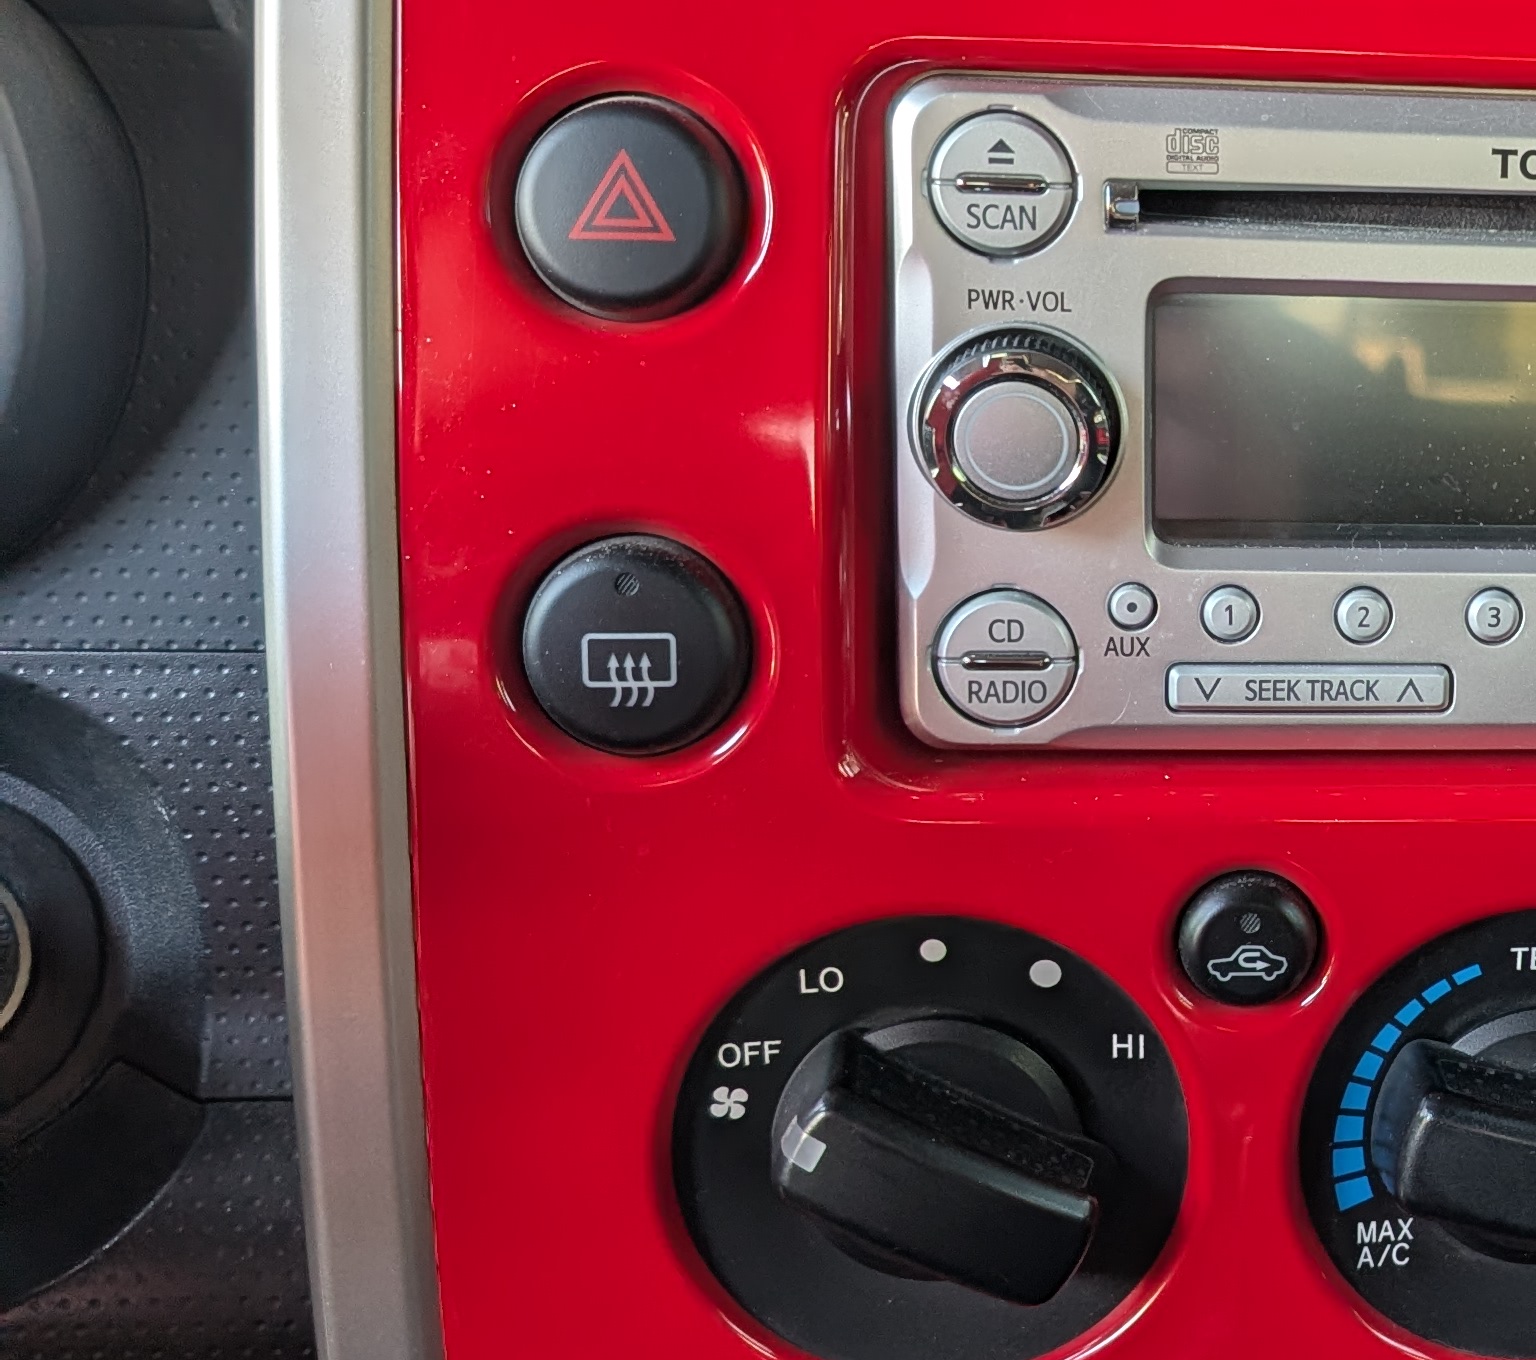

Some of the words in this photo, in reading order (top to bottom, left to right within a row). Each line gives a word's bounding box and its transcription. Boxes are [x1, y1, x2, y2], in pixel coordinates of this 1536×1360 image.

[1166, 128, 1219, 155] disc
[966, 203, 1037, 232] SCAN
[1224, 604, 1234, 626] 1
[1357, 606, 1371, 628] 2
[1487, 606, 1501, 628] 3
[987, 618, 1025, 644] CD
[1103, 636, 1151, 658] AUX
[967, 679, 1048, 705] RADIO
[1244, 679, 1300, 702] SEEK
[1306, 679, 1380, 702] TRACK
[799, 967, 844, 994] LO
[717, 1040, 782, 1068] OFF
[1112, 1033, 1145, 1059] HI
[1356, 1218, 1414, 1245] MAX
[1356, 1242, 1410, 1270] A/C
